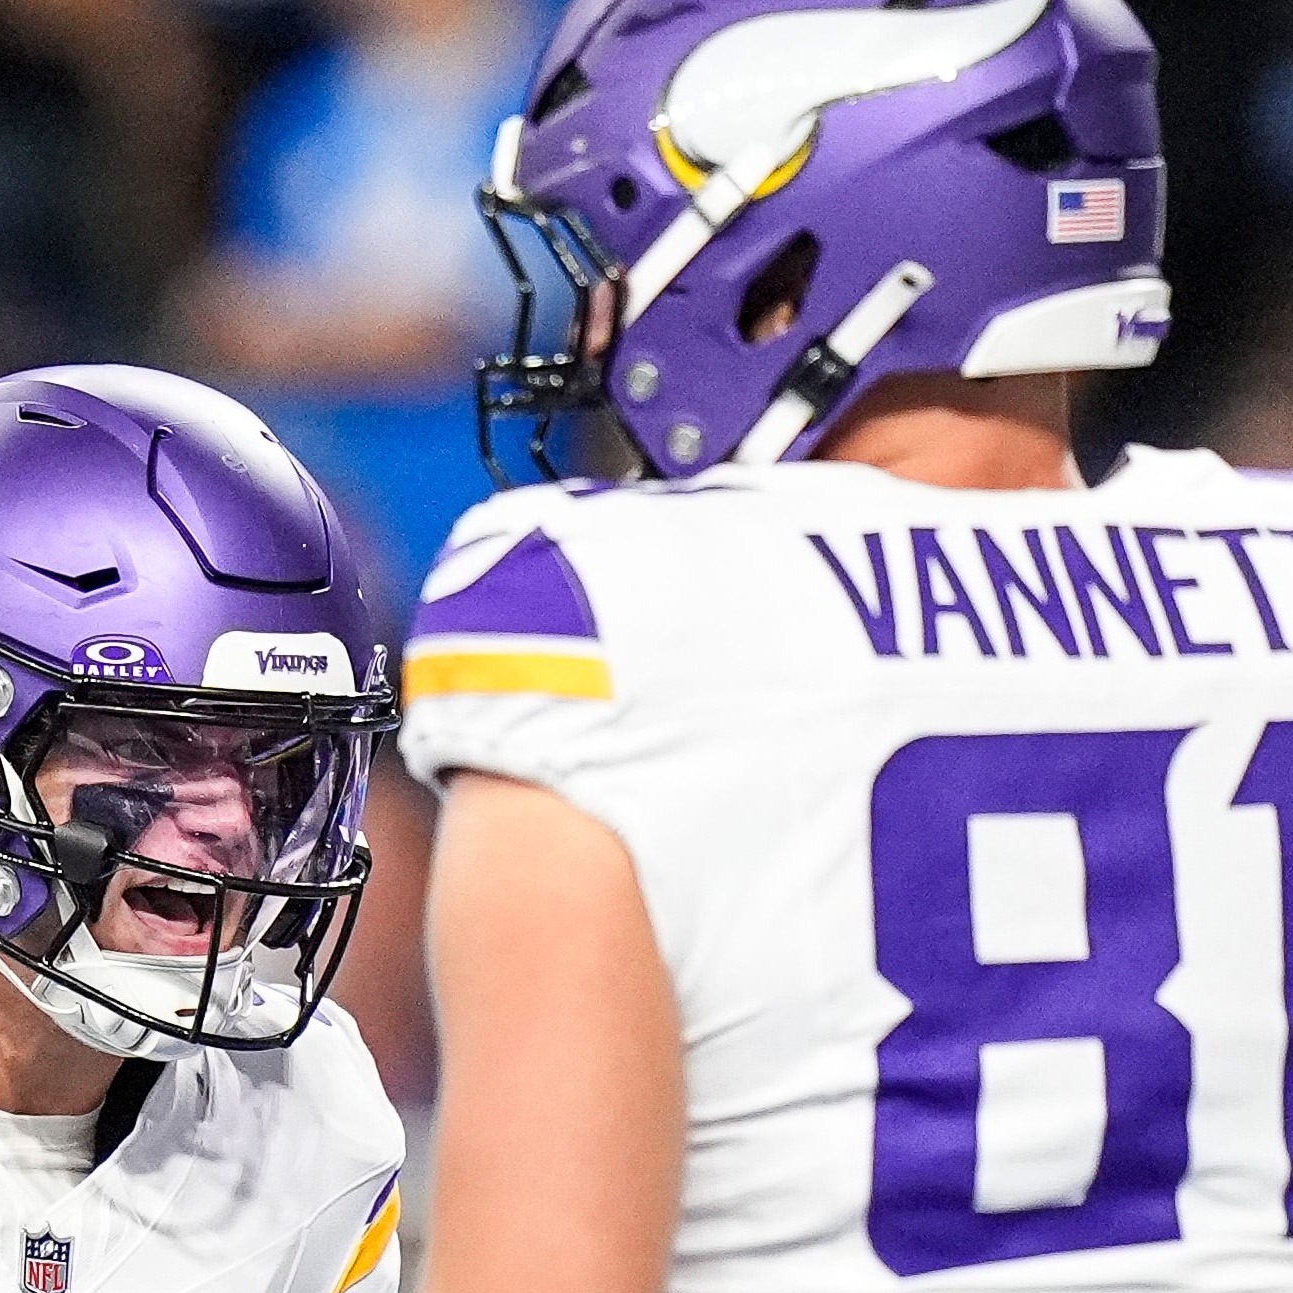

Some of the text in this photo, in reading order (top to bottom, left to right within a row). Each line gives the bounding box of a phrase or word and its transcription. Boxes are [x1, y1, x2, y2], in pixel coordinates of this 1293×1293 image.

[807, 525, 1293, 657] VANNET
[72, 663, 158, 678] OAKLEY
[27, 1260, 65, 1293] NFL
